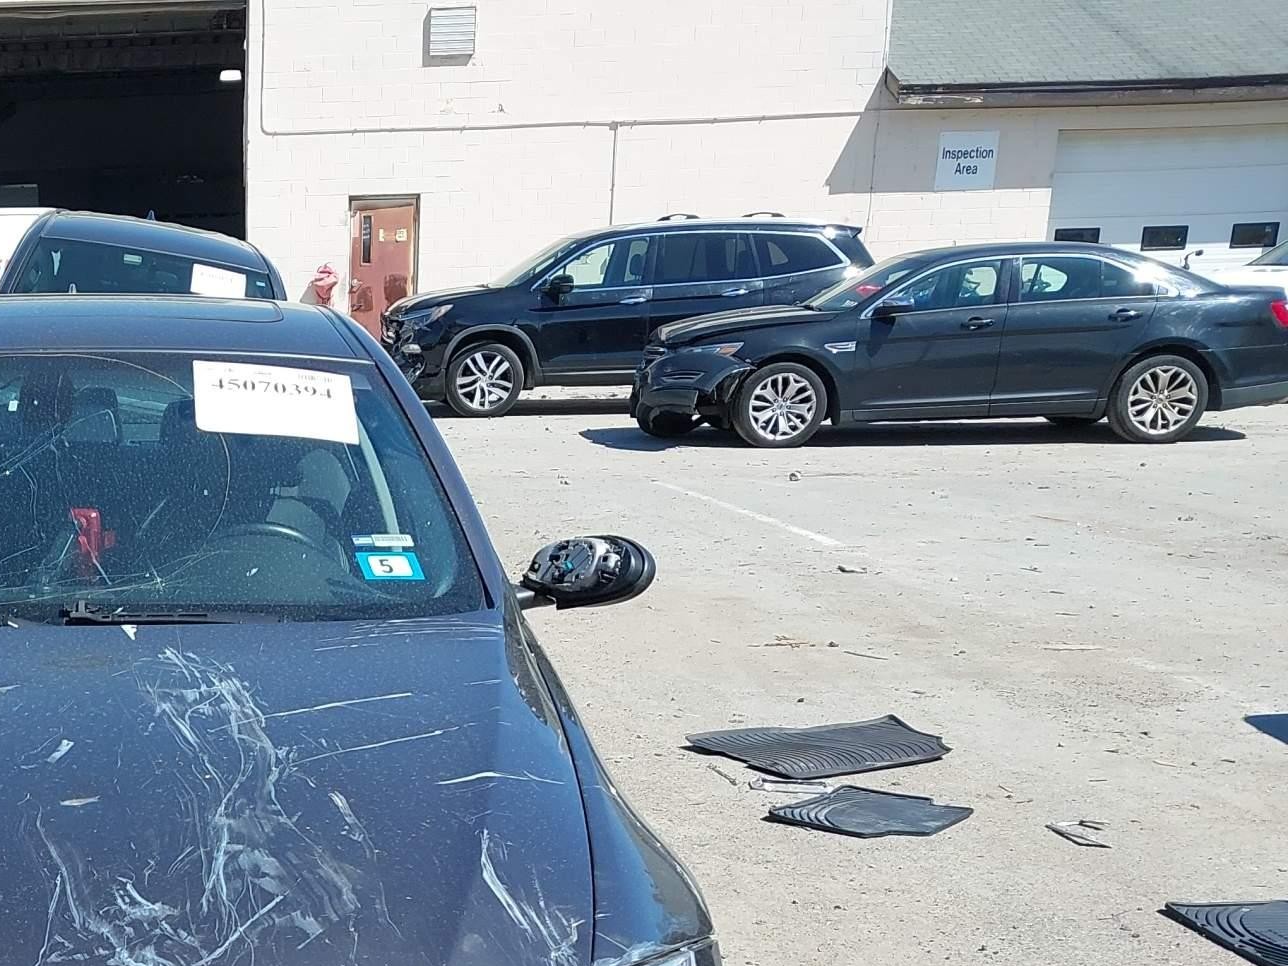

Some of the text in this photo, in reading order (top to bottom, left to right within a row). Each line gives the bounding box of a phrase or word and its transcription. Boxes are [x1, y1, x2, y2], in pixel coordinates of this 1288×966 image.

[941, 146, 994, 161] Inspection
[954, 162, 978, 175] Area
[211, 377, 332, 399] 45070394
[378, 558, 394, 574] 5
